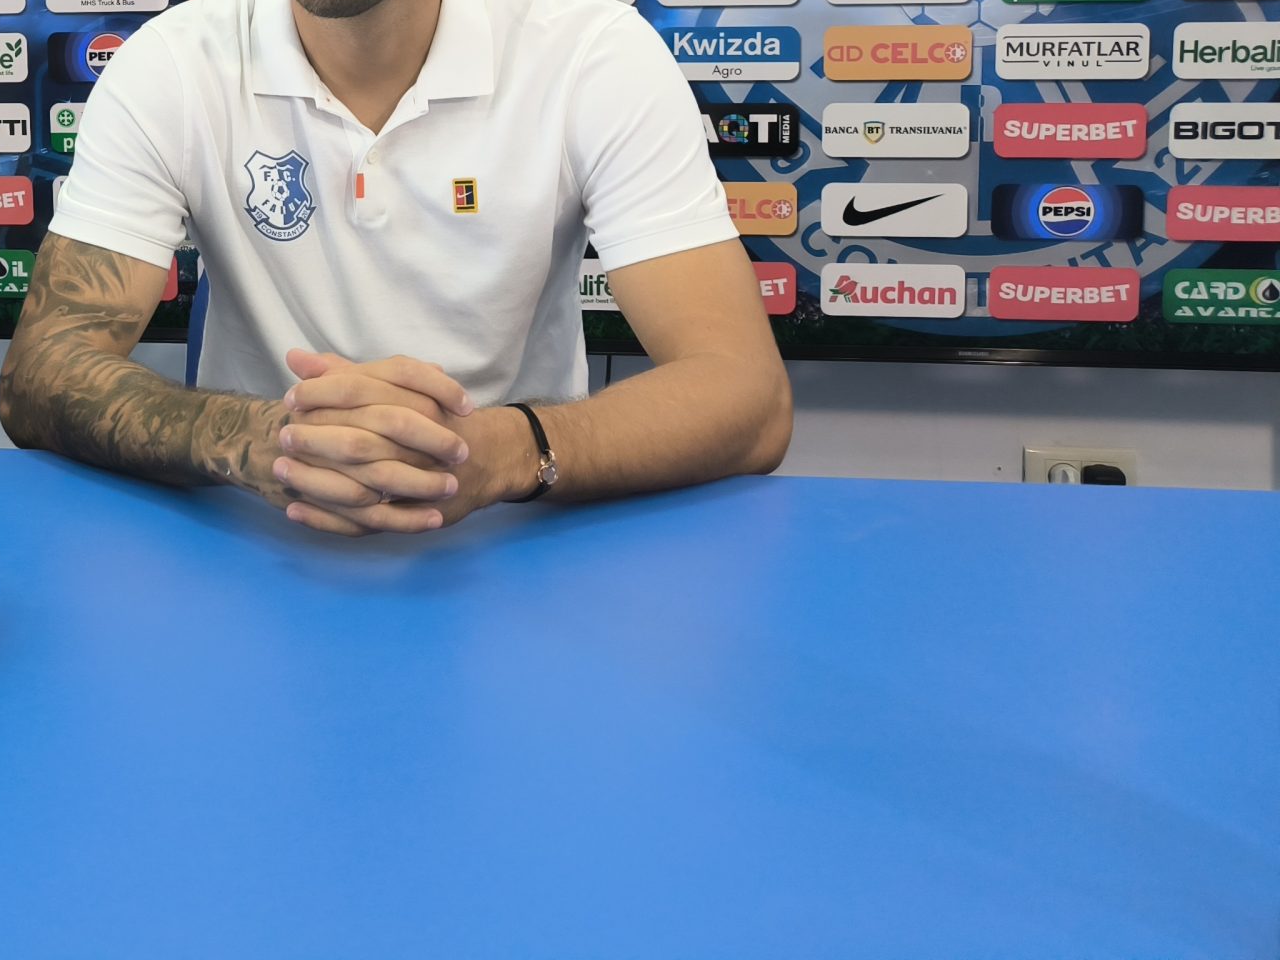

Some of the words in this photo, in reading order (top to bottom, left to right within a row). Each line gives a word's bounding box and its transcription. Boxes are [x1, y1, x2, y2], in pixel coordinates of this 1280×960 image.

[672, 32, 781, 56] Kwizda
[1006, 41, 1140, 58] MURFATLAR
[88, 51, 115, 61] PEP
[1043, 60, 1103, 68] VINUL
[711, 65, 742, 78] Agro
[782, 113, 791, 144] MEDIA
[824, 126, 859, 136] BANCA
[866, 127, 881, 135] BT
[1003, 119, 1138, 142] SUPERBET
[726, 197, 794, 220] ELCO
[1041, 205, 1092, 218] PEPSI
[828, 274, 957, 305] Auchan
[998, 282, 1130, 305] SUPERBET
